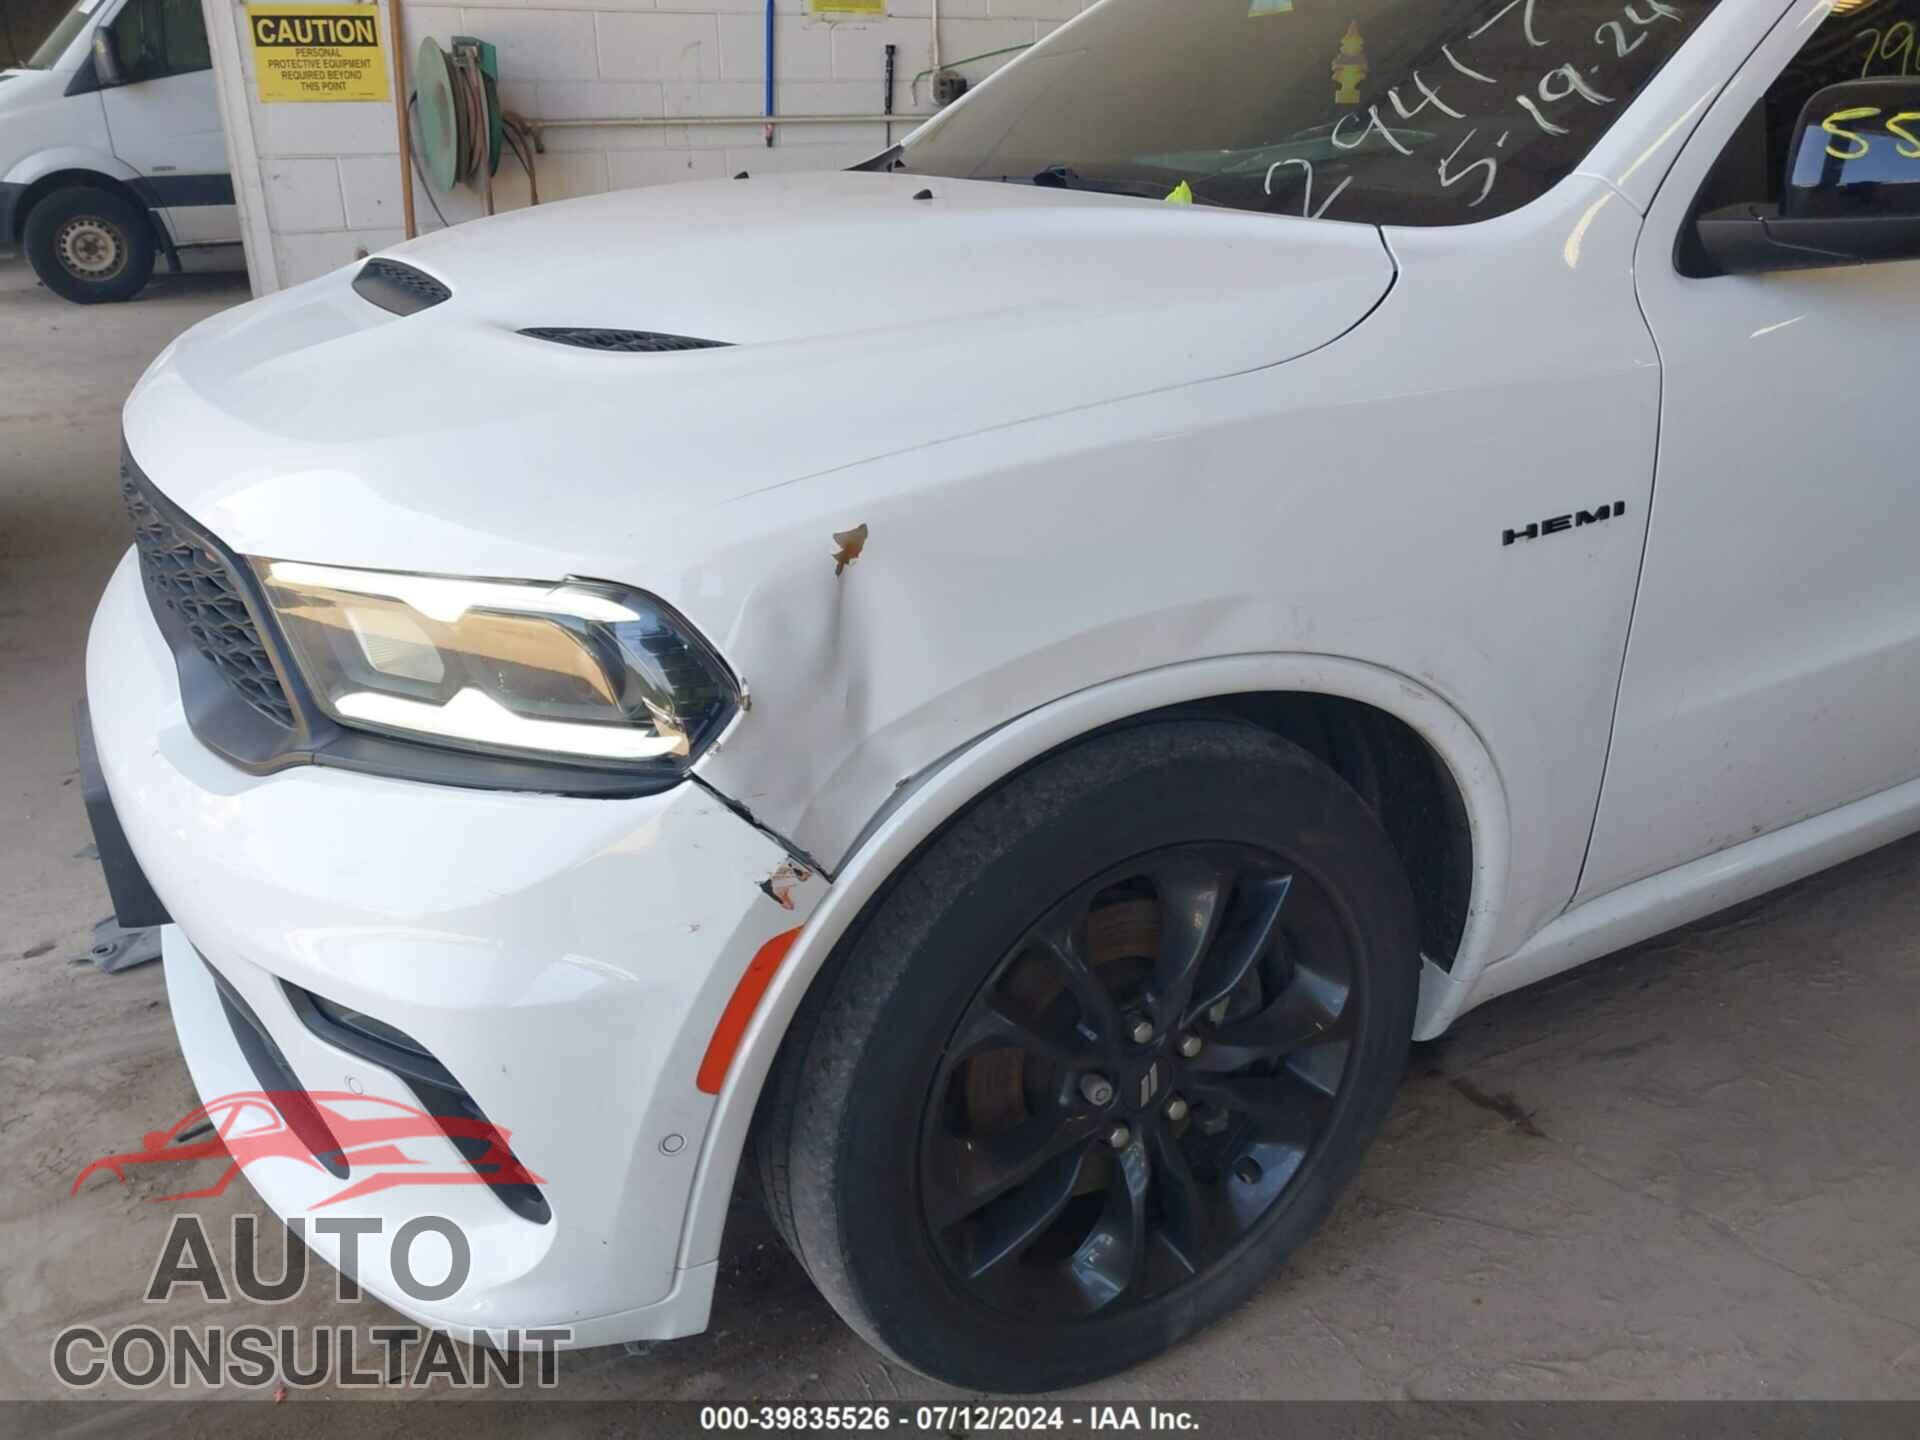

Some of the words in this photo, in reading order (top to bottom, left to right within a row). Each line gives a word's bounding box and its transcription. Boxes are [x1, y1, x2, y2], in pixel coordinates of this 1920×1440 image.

[256, 18, 374, 44] CAUTION
[295, 48, 342, 57] PERSONAL
[268, 59, 321, 69] PROTECTIVE
[323, 59, 371, 69] EQUIPMENT
[281, 70, 326, 80] REQUIRED
[327, 70, 362, 80] BEYOND
[300, 82, 320, 91] THIS
[321, 81, 346, 91] POINT
[1502, 500, 1626, 547] HEMI
